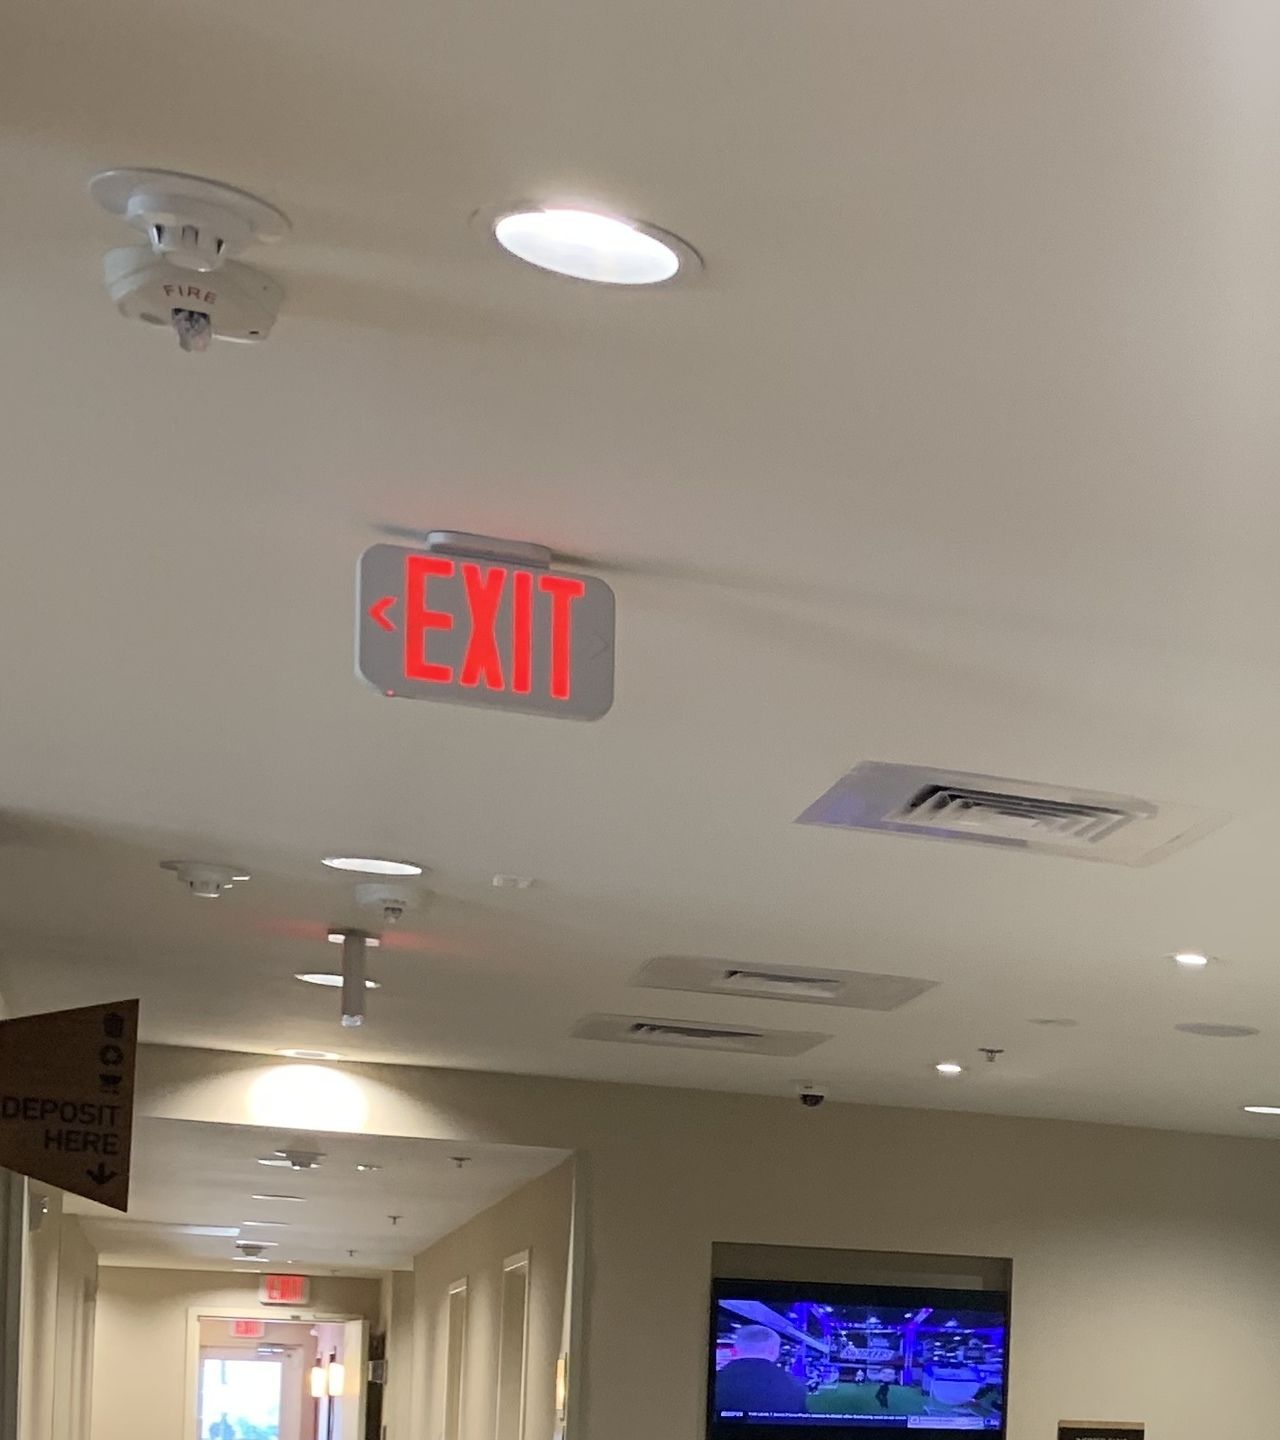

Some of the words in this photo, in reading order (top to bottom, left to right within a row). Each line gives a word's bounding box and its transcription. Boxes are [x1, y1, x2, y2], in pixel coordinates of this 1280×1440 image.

[163, 284, 217, 305] FIRE
[403, 553, 586, 701] EXIT
[2, 1095, 121, 1126] DEPOSIT
[44, 1129, 119, 1155] HERE
